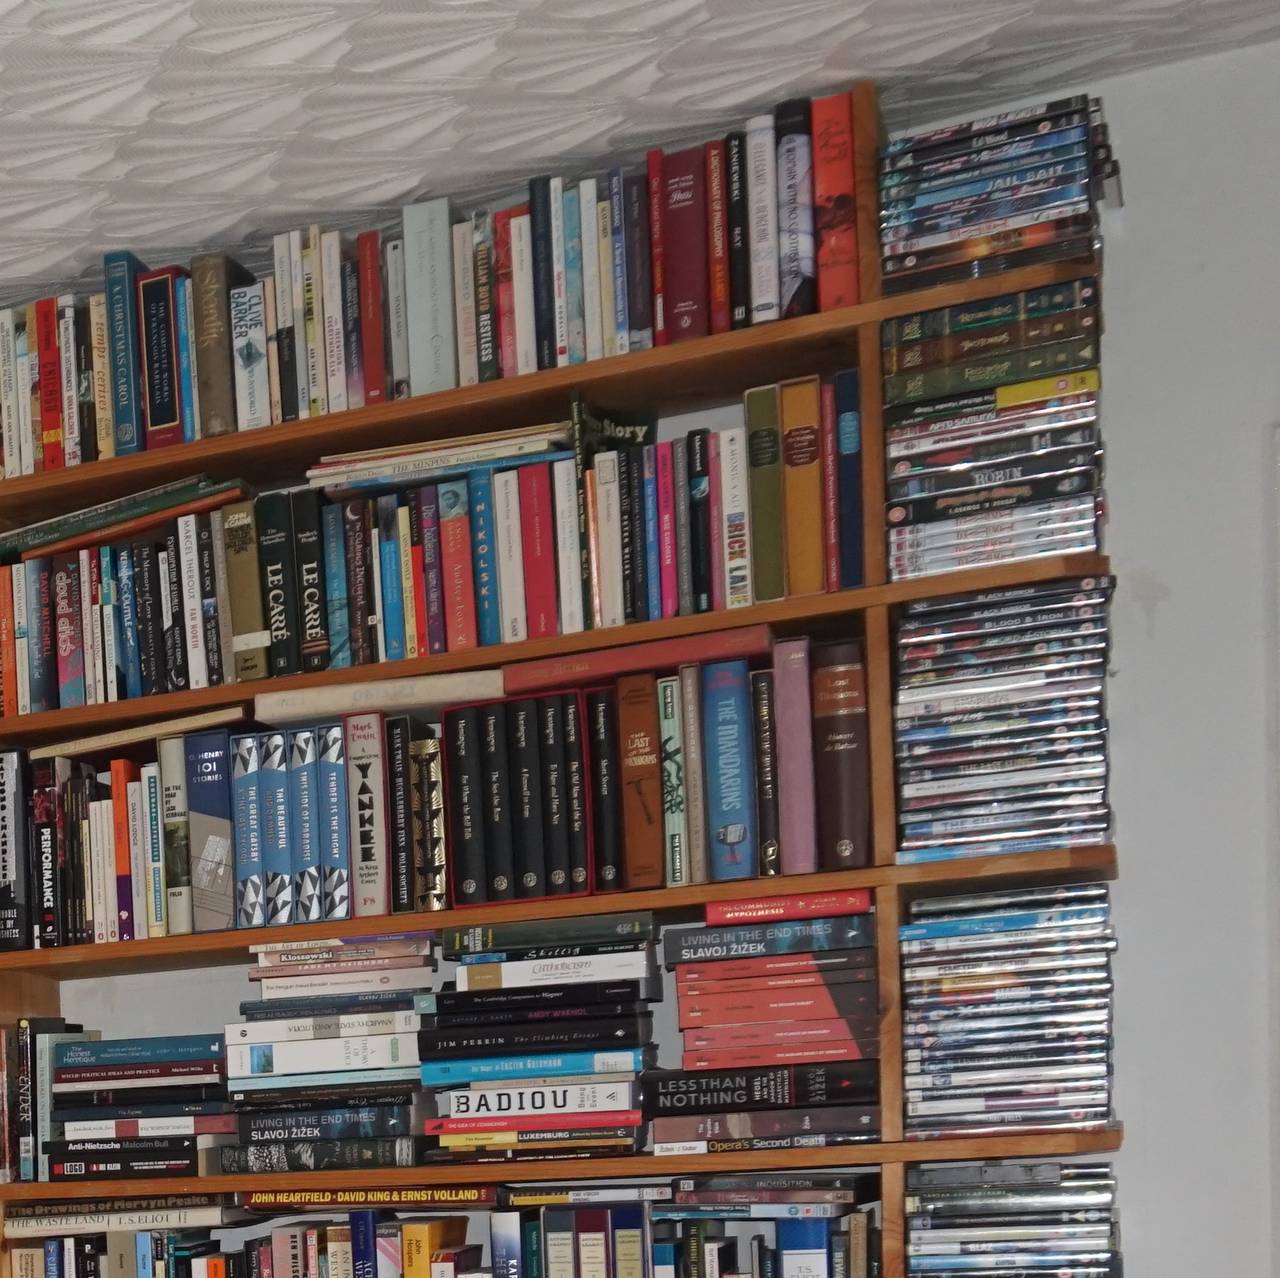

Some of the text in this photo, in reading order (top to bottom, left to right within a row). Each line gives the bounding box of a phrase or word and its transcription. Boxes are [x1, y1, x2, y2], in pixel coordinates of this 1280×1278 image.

[248, 295, 263, 329] CLIVE
[477, 243, 492, 361] WILLIAM BOYD RESTLESS
[231, 291, 249, 339] BARKER
[92, 322, 105, 358] temps
[113, 294, 126, 363] CHRISTMAS
[42, 362, 57, 412] CHICAGO
[97, 370, 108, 410] cerises
[117, 367, 129, 407] CAROL
[183, 520, 195, 600] MARCEL THEROUX
[727, 512, 749, 606] BRICK LANE
[267, 562, 290, 641] LE CARRÉ
[303, 561, 324, 640] LE CARRÉ
[55, 572, 75, 656] cloud atlas
[717, 697, 741, 811] THE MANDARINS
[193, 774, 222, 783] STORIES
[197, 762, 217, 772] 101
[300, 791, 308, 804] SIDE
[329, 772, 337, 802] TENDER
[0, 757, 8, 879] RAYMOND CHANDLER
[277, 805, 286, 848] BEAUTIFUL
[301, 809, 309, 820] OF
[250, 832, 258, 861] GATSBY
[302, 823, 310, 861] PARADISE
[331, 833, 339, 858] NIGHT
[41, 828, 53, 908] PERFORMANCE
[682, 925, 834, 946] LIVING IN THE END TIMES
[281, 952, 333, 962] Klossowski
[682, 940, 767, 959] SLAVOJ ŽIŽEK
[437, 1036, 505, 1049] JIM PERRIN
[659, 1076, 748, 1094] LESS THAN
[458, 1089, 569, 1114] BADIOU
[660, 1091, 749, 1108] NOTHING
[251, 1112, 375, 1129] LIVING IN THE END TIMES
[68, 1141, 120, 1151] Anti-Nietzsche
[122, 1142, 153, 1150] Malcolm
[251, 1126, 320, 1141] SLAVOJ ŽIŽEK
[517, 1131, 570, 1141] LUXEMBURG
[710, 1136, 827, 1152] Opera's Second Death
[64, 1164, 84, 1174] LOGO
[251, 1189, 478, 1203] JOHN HEARTFIELD DAVID KING & ERNST VOLLAND
[11, 1215, 104, 1229] THE WASTE LAND
[290, 1234, 298, 1249] BEN
